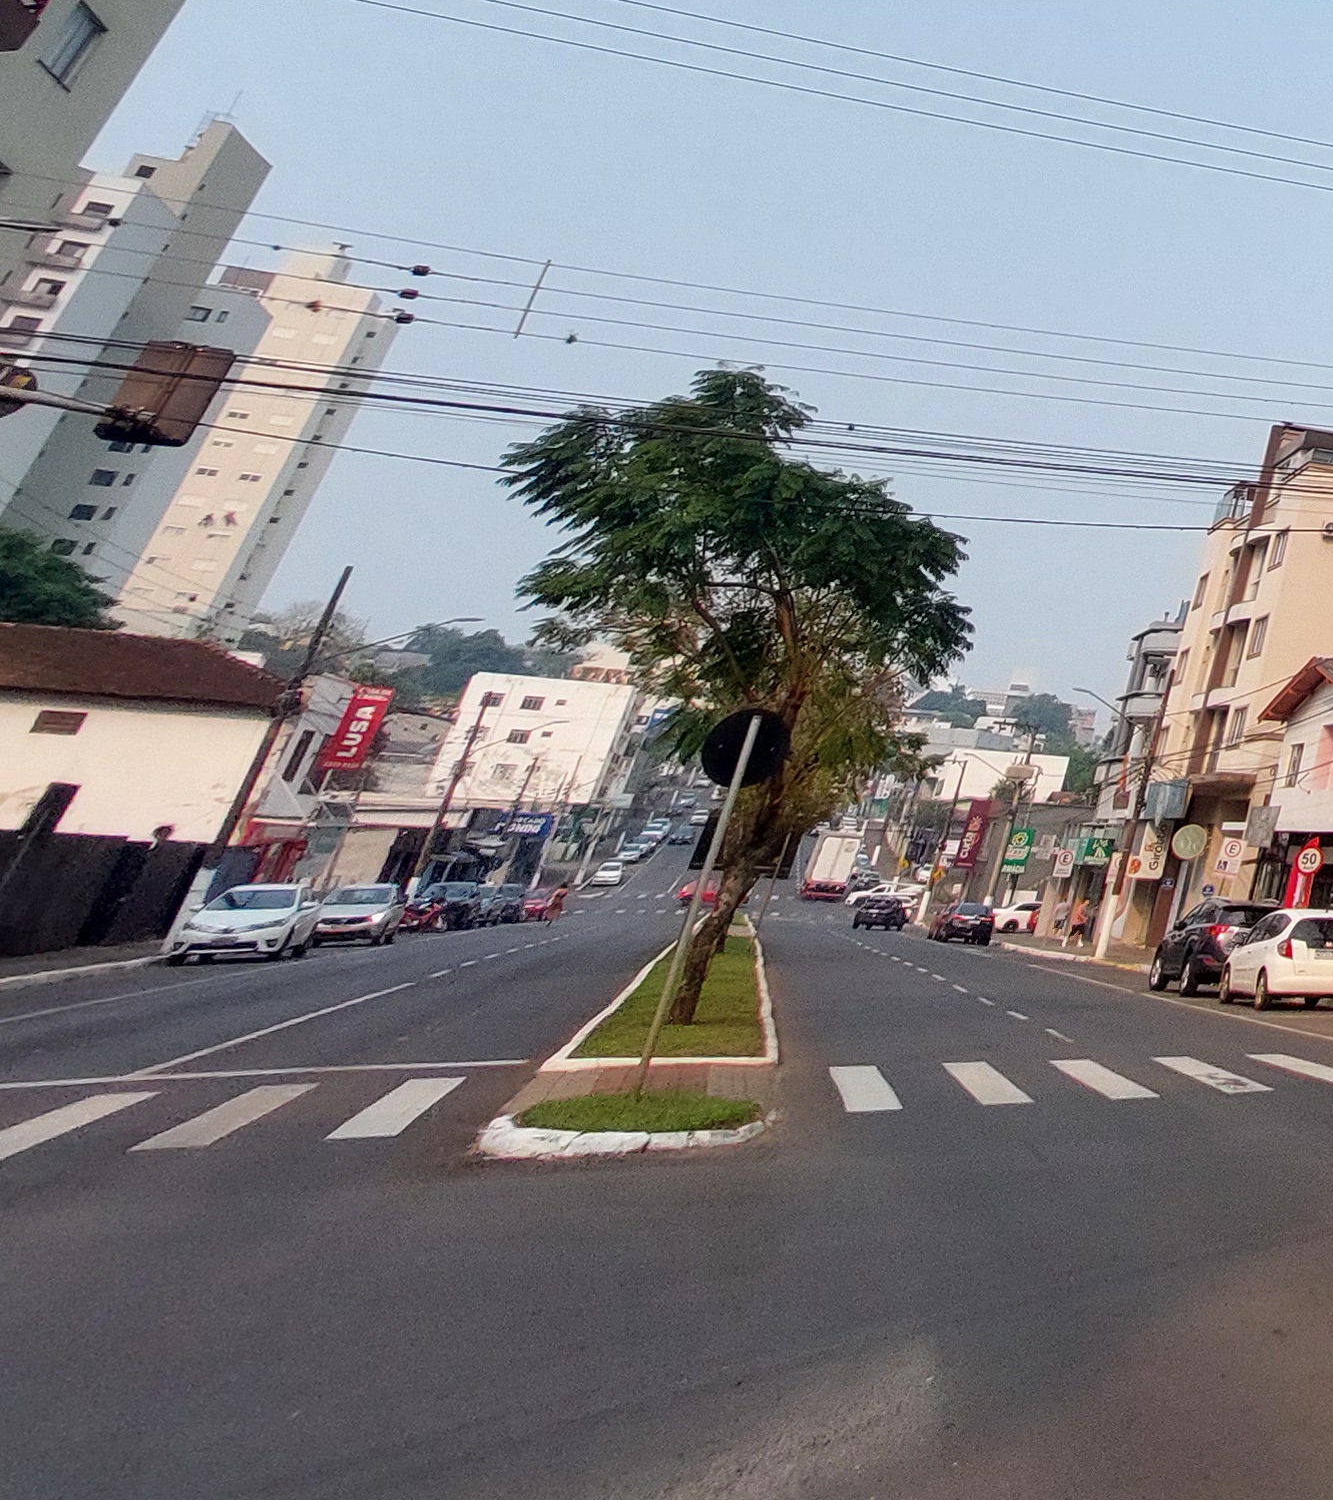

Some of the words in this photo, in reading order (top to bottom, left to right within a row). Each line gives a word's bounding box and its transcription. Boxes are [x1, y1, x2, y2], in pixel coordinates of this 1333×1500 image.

[336, 705, 377, 758] LUSA
[1229, 844, 1237, 854] E
[1062, 854, 1069, 863] E
[1301, 853, 1317, 865] 50
